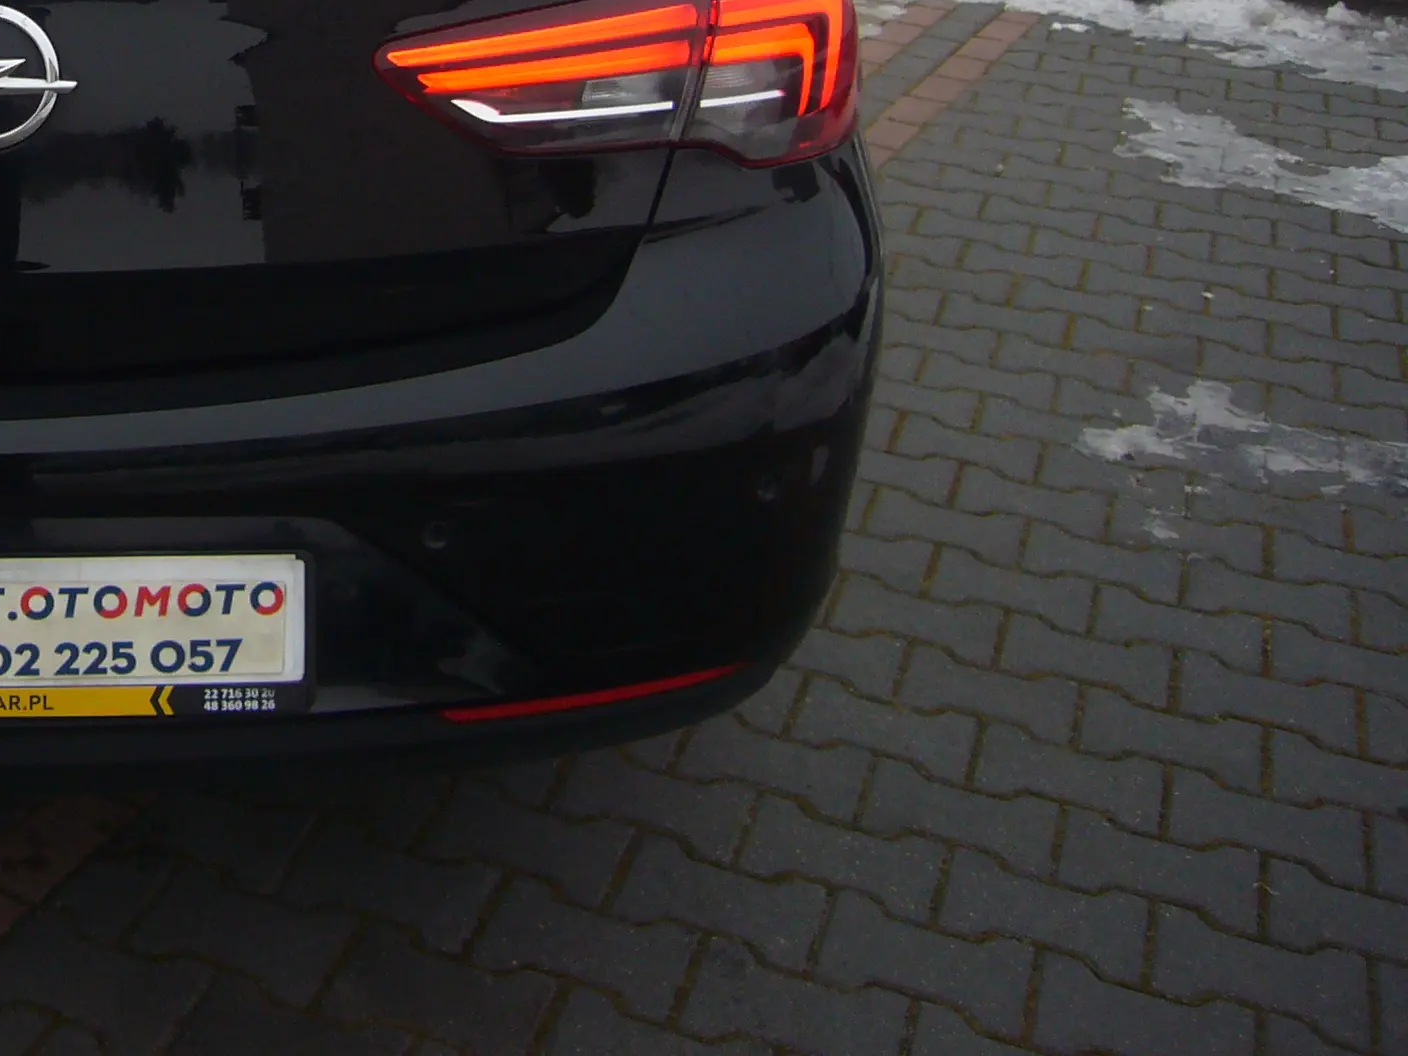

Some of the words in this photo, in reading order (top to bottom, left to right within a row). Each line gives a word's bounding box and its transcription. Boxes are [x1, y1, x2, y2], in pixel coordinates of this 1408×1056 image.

[54, 640, 137, 676] 225
[150, 637, 244, 674] 057
[204, 688, 219, 699] 22
[221, 688, 243, 699] 716
[244, 688, 259, 699] 30
[221, 700, 243, 711] 360
